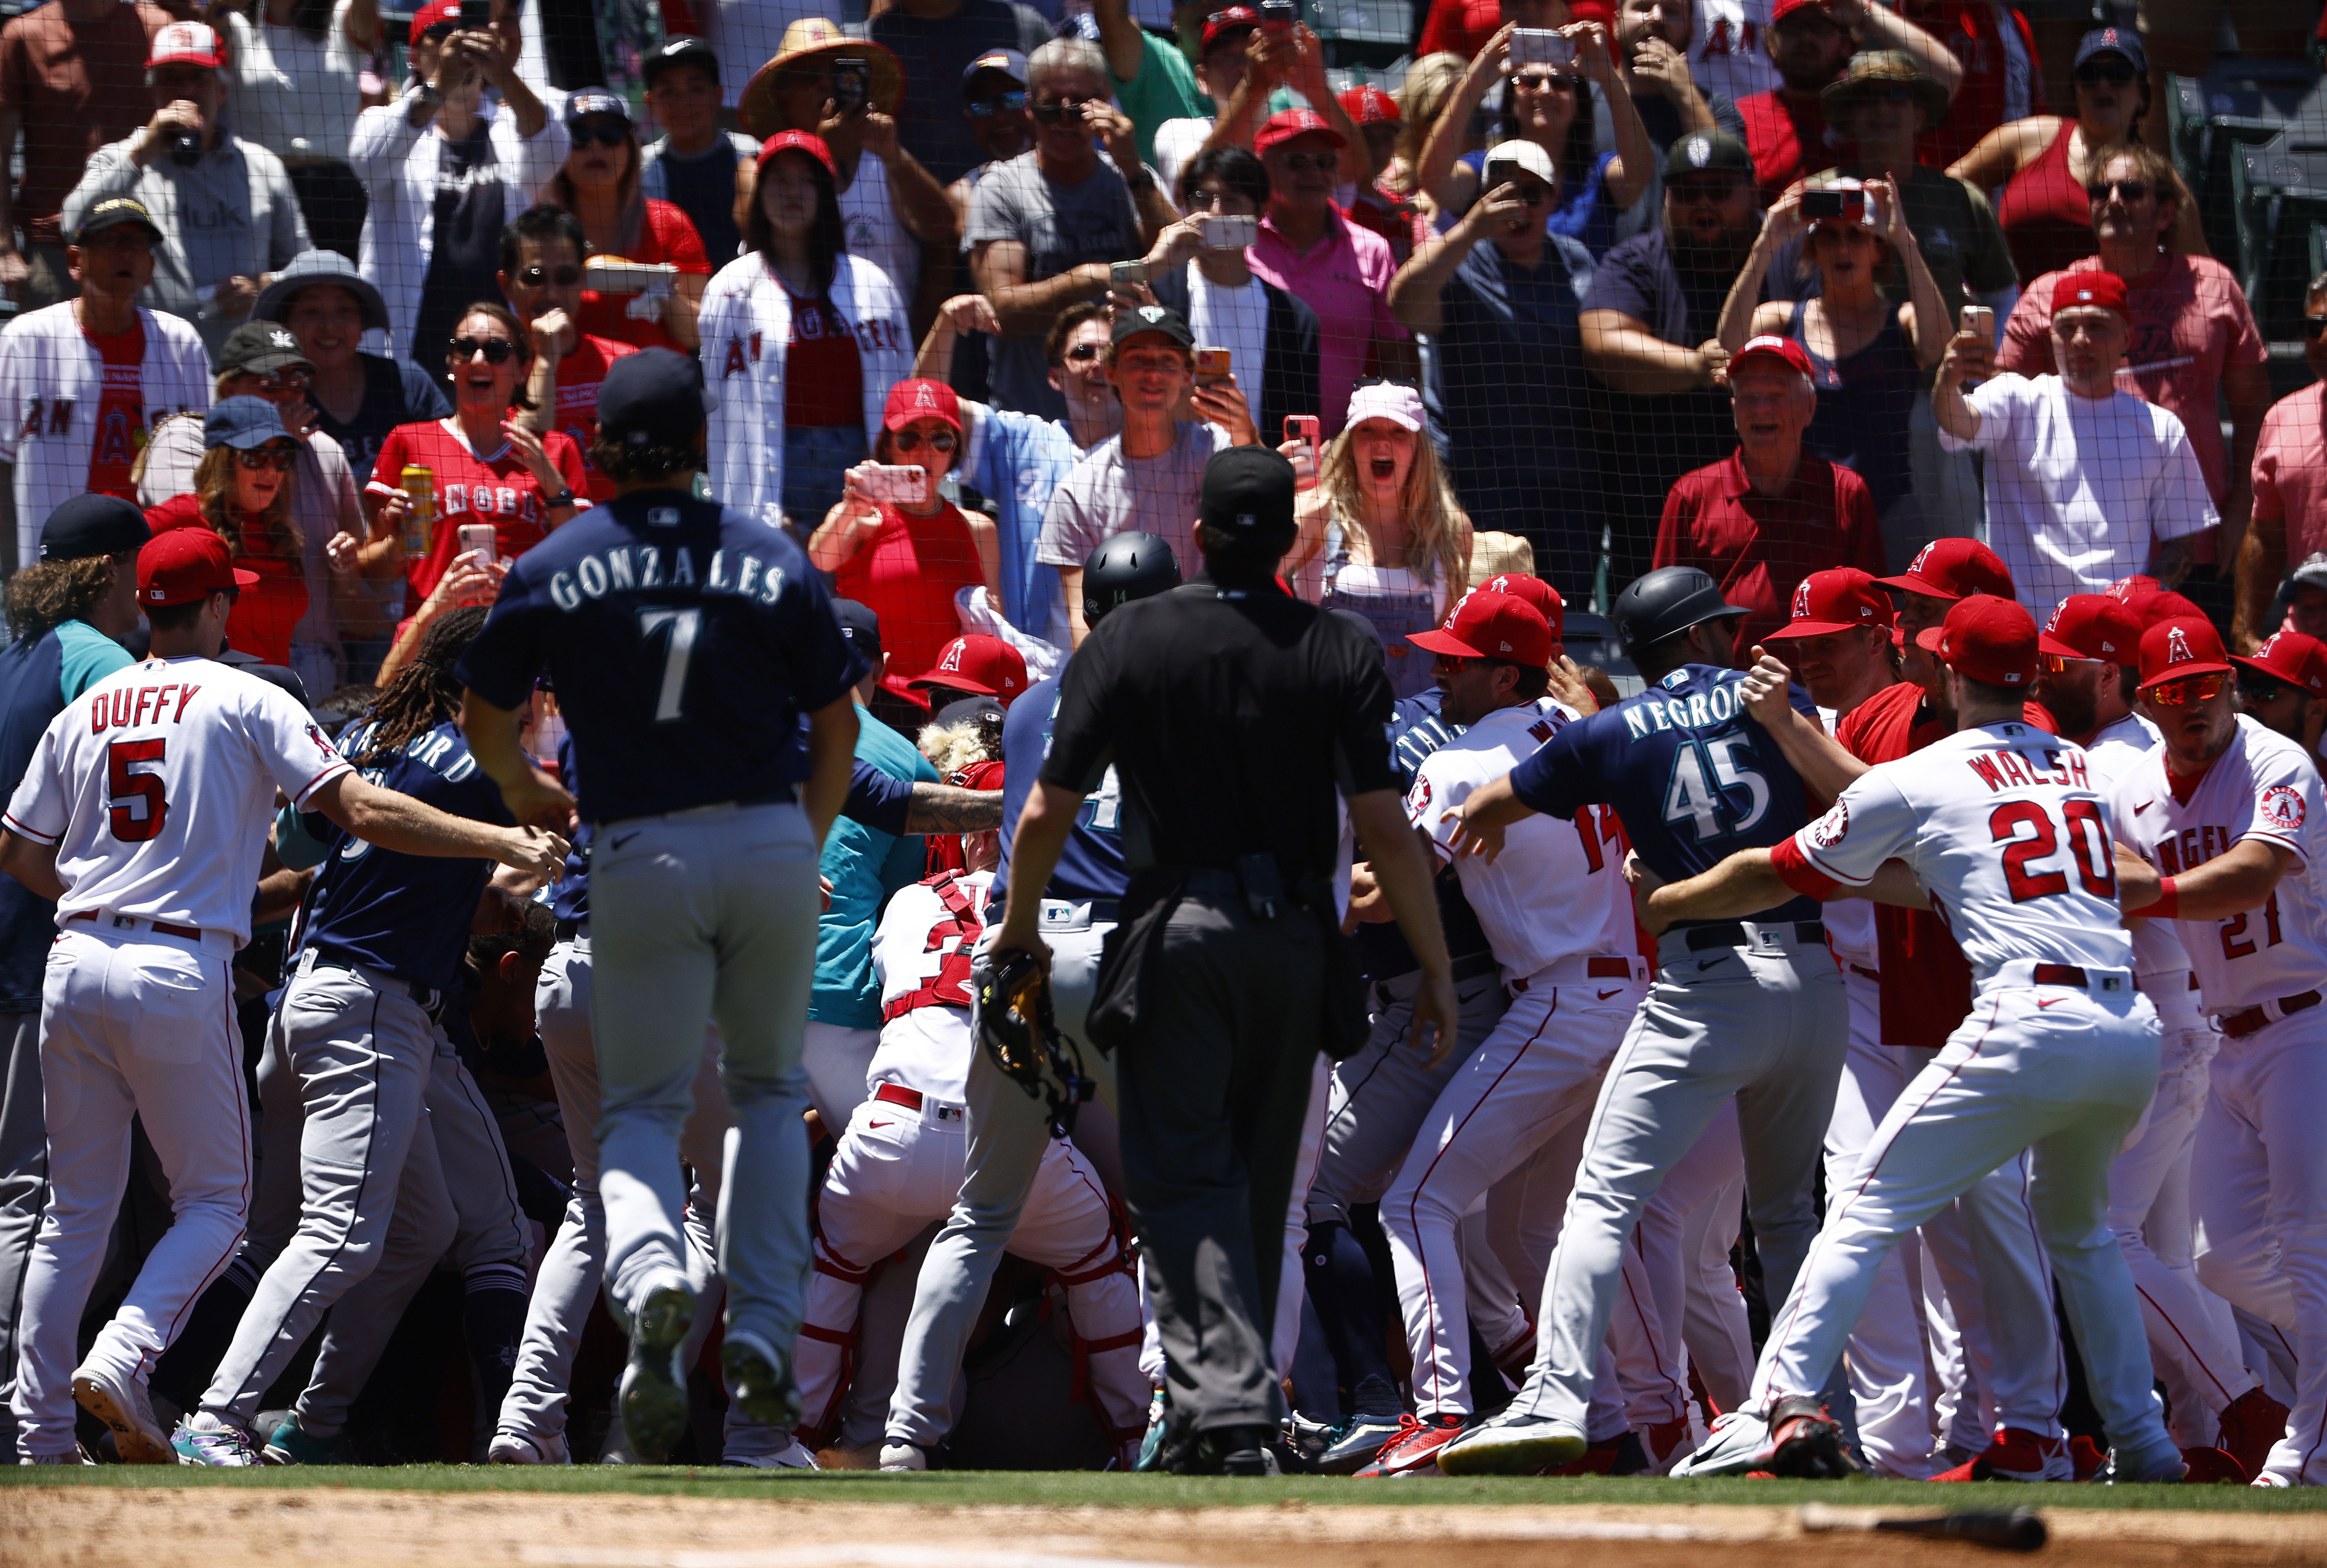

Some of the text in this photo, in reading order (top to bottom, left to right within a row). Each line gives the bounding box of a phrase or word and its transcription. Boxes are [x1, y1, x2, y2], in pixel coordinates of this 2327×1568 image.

[92, 405, 132, 464] A
[549, 544, 786, 613] GONZALES
[1793, 579, 1811, 619] A
[635, 605, 704, 726] 7
[939, 638, 967, 672] A
[2168, 626, 2195, 664] A
[92, 683, 202, 735] DUFFY
[107, 738, 174, 843] 5
[1660, 728, 1772, 846] 45
[1966, 749, 2092, 794] WALSH
[1989, 799, 2117, 905] 20
